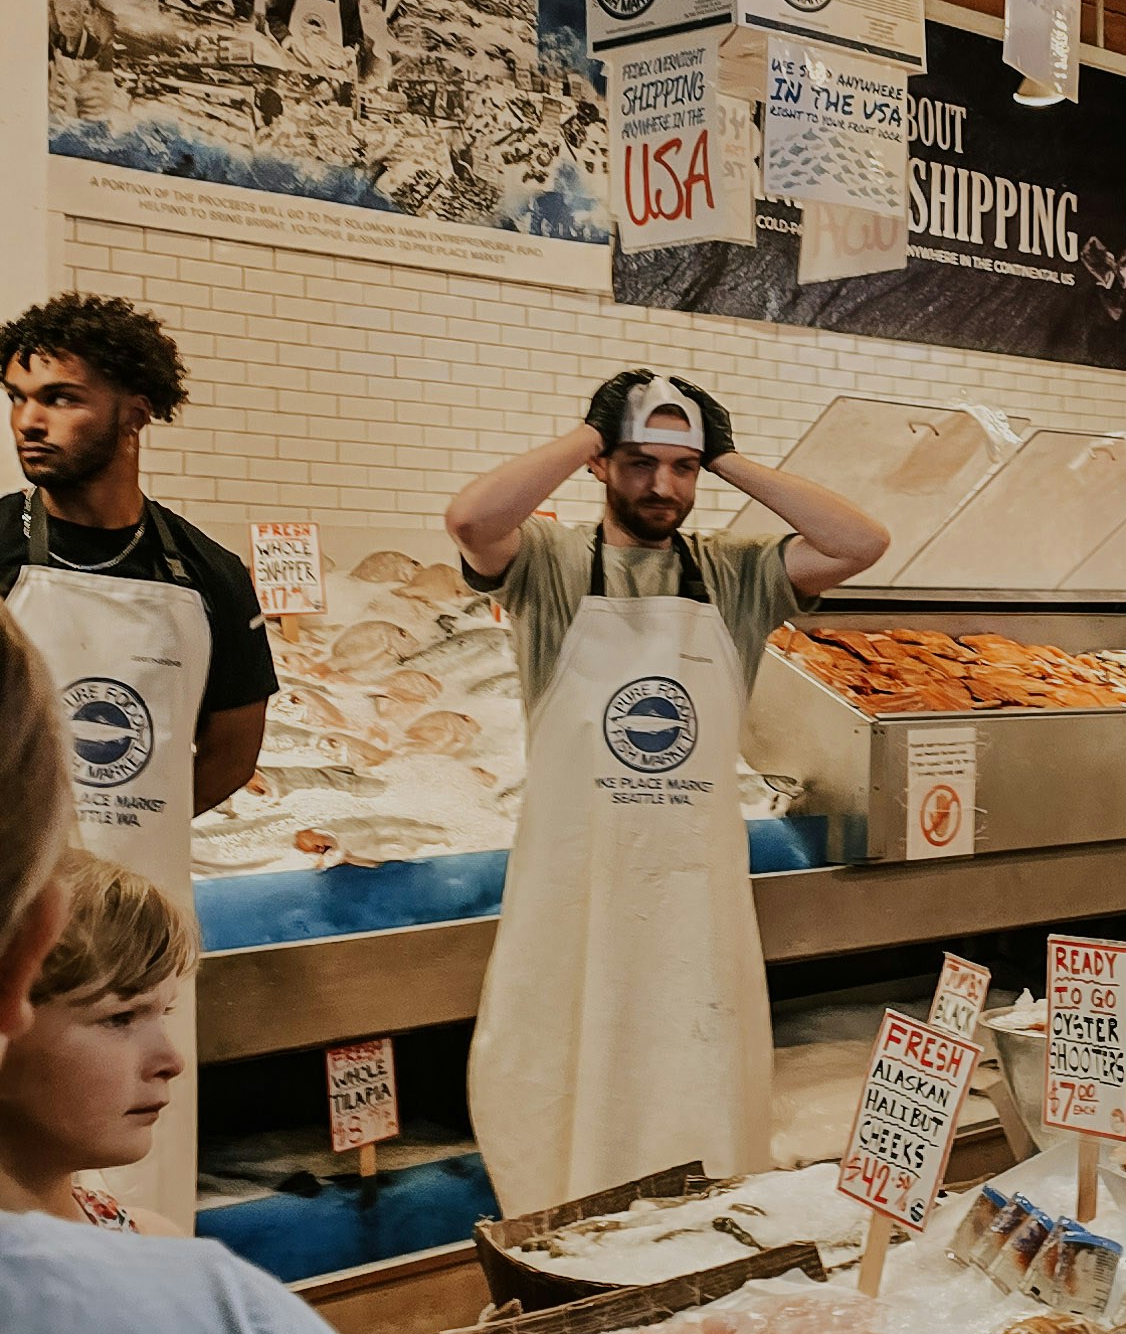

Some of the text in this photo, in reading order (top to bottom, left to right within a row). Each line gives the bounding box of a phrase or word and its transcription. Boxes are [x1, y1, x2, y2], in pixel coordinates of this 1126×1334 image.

[621, 70, 705, 116] SHIPPING
[770, 78, 902, 128] IN THE USA
[836, 74, 903, 101] ANYWHERE
[621, 107, 706, 139] ANYWHERE IN THE
[769, 105, 805, 119] RIGHT
[806, 112, 819, 123] TO
[821, 115, 846, 131] YOUR
[847, 122, 876, 138] FRONT
[907, 94, 967, 154] BOUT
[624, 129, 715, 226] USA
[101, 179, 151, 196] PORTION
[155, 187, 170, 198] OF
[174, 190, 194, 203] THE
[198, 195, 255, 212] PROCEEDS
[259, 204, 282, 217] WILL
[287, 207, 303, 220] GO
[306, 210, 320, 222] TO
[323, 214, 341, 227] THE
[345, 218, 395, 235] SOLOMON
[907, 156, 1079, 262] SHIPPING
[138, 199, 187, 217] HELPING
[190, 207, 206, 220] TO
[210, 210, 243, 227] BRING
[347, 233, 395, 248] BUSINESS
[399, 240, 412, 251] TO
[413, 241, 434, 255] PIKE
[436, 245, 468, 259] PLACE
[959, 254, 971, 267] IN
[973, 256, 993, 272] THE
[993, 260, 1060, 284] CONTINENTAL
[1060, 272, 1076, 286] US
[256, 541, 313, 557] WHOLE
[63, 685, 99, 707] URE
[614, 683, 691, 717] PURE FOOD
[612, 793, 665, 804] SEATTLE
[620, 778, 662, 789] PLACE
[667, 778, 714, 793] MARKE
[116, 795, 167, 813] MARKE
[1055, 946, 1117, 979] READY
[1054, 986, 1117, 1009] TO GO
[1052, 1012, 1119, 1043] OYSTER
[883, 1023, 964, 1078] FRESH
[1049, 1042, 1125, 1083] SHOOTERS
[872, 1059, 950, 1108] ALASKAN
[866, 1089, 943, 1137] HALIBUT
[859, 1120, 925, 1168] CHEEKS
